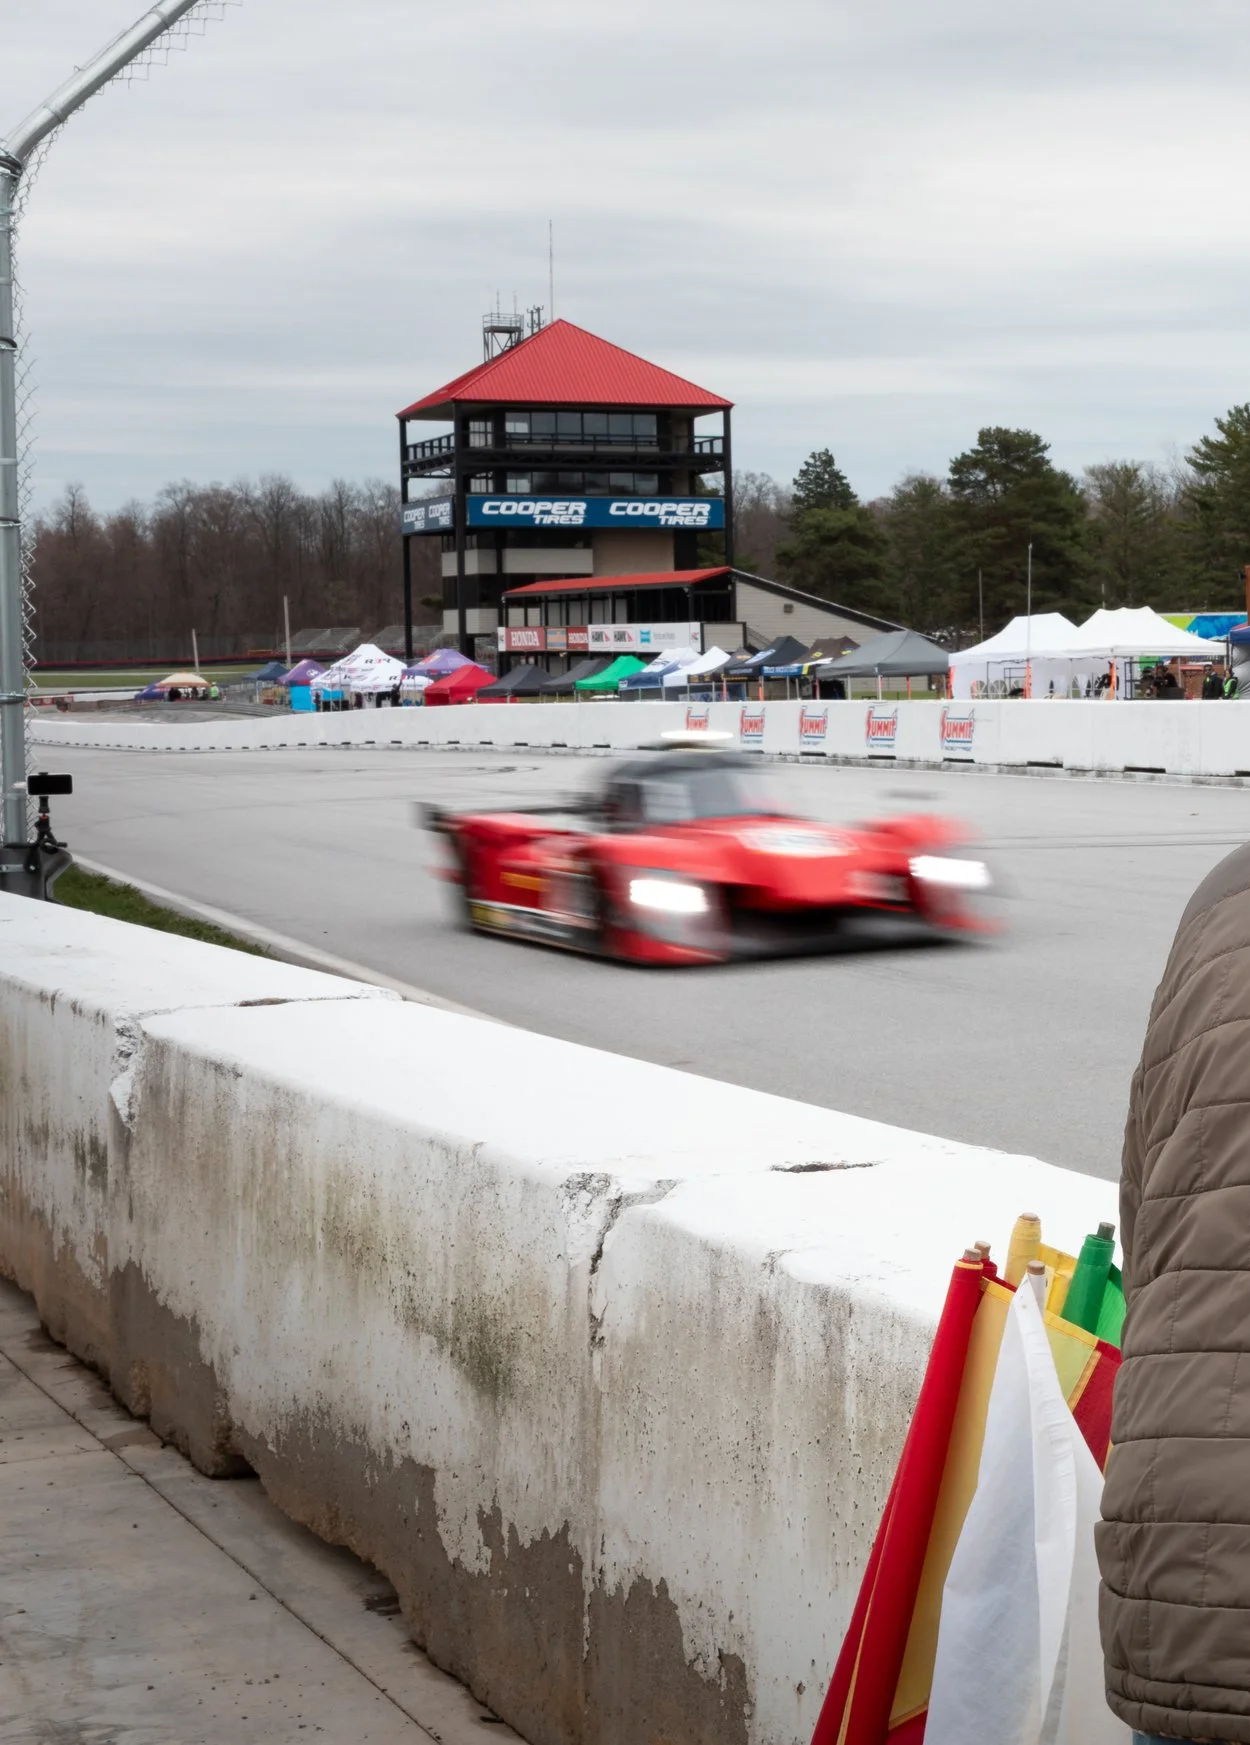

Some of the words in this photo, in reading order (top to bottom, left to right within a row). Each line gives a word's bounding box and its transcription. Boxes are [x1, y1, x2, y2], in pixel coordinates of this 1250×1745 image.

[404, 507, 425, 523] COOPER
[429, 502, 450, 517] COOPER
[481, 501, 587, 515] COOPER
[609, 502, 711, 516] COOPER
[533, 515, 585, 525] TIRES
[658, 515, 709, 525] TIRES
[510, 631, 540, 646] HONDA
[740, 707, 765, 736] SUMMIT
[799, 707, 828, 737] SUMMIT
[866, 708, 898, 740] SUMMIT
[939, 709, 975, 742] SUMMIT
